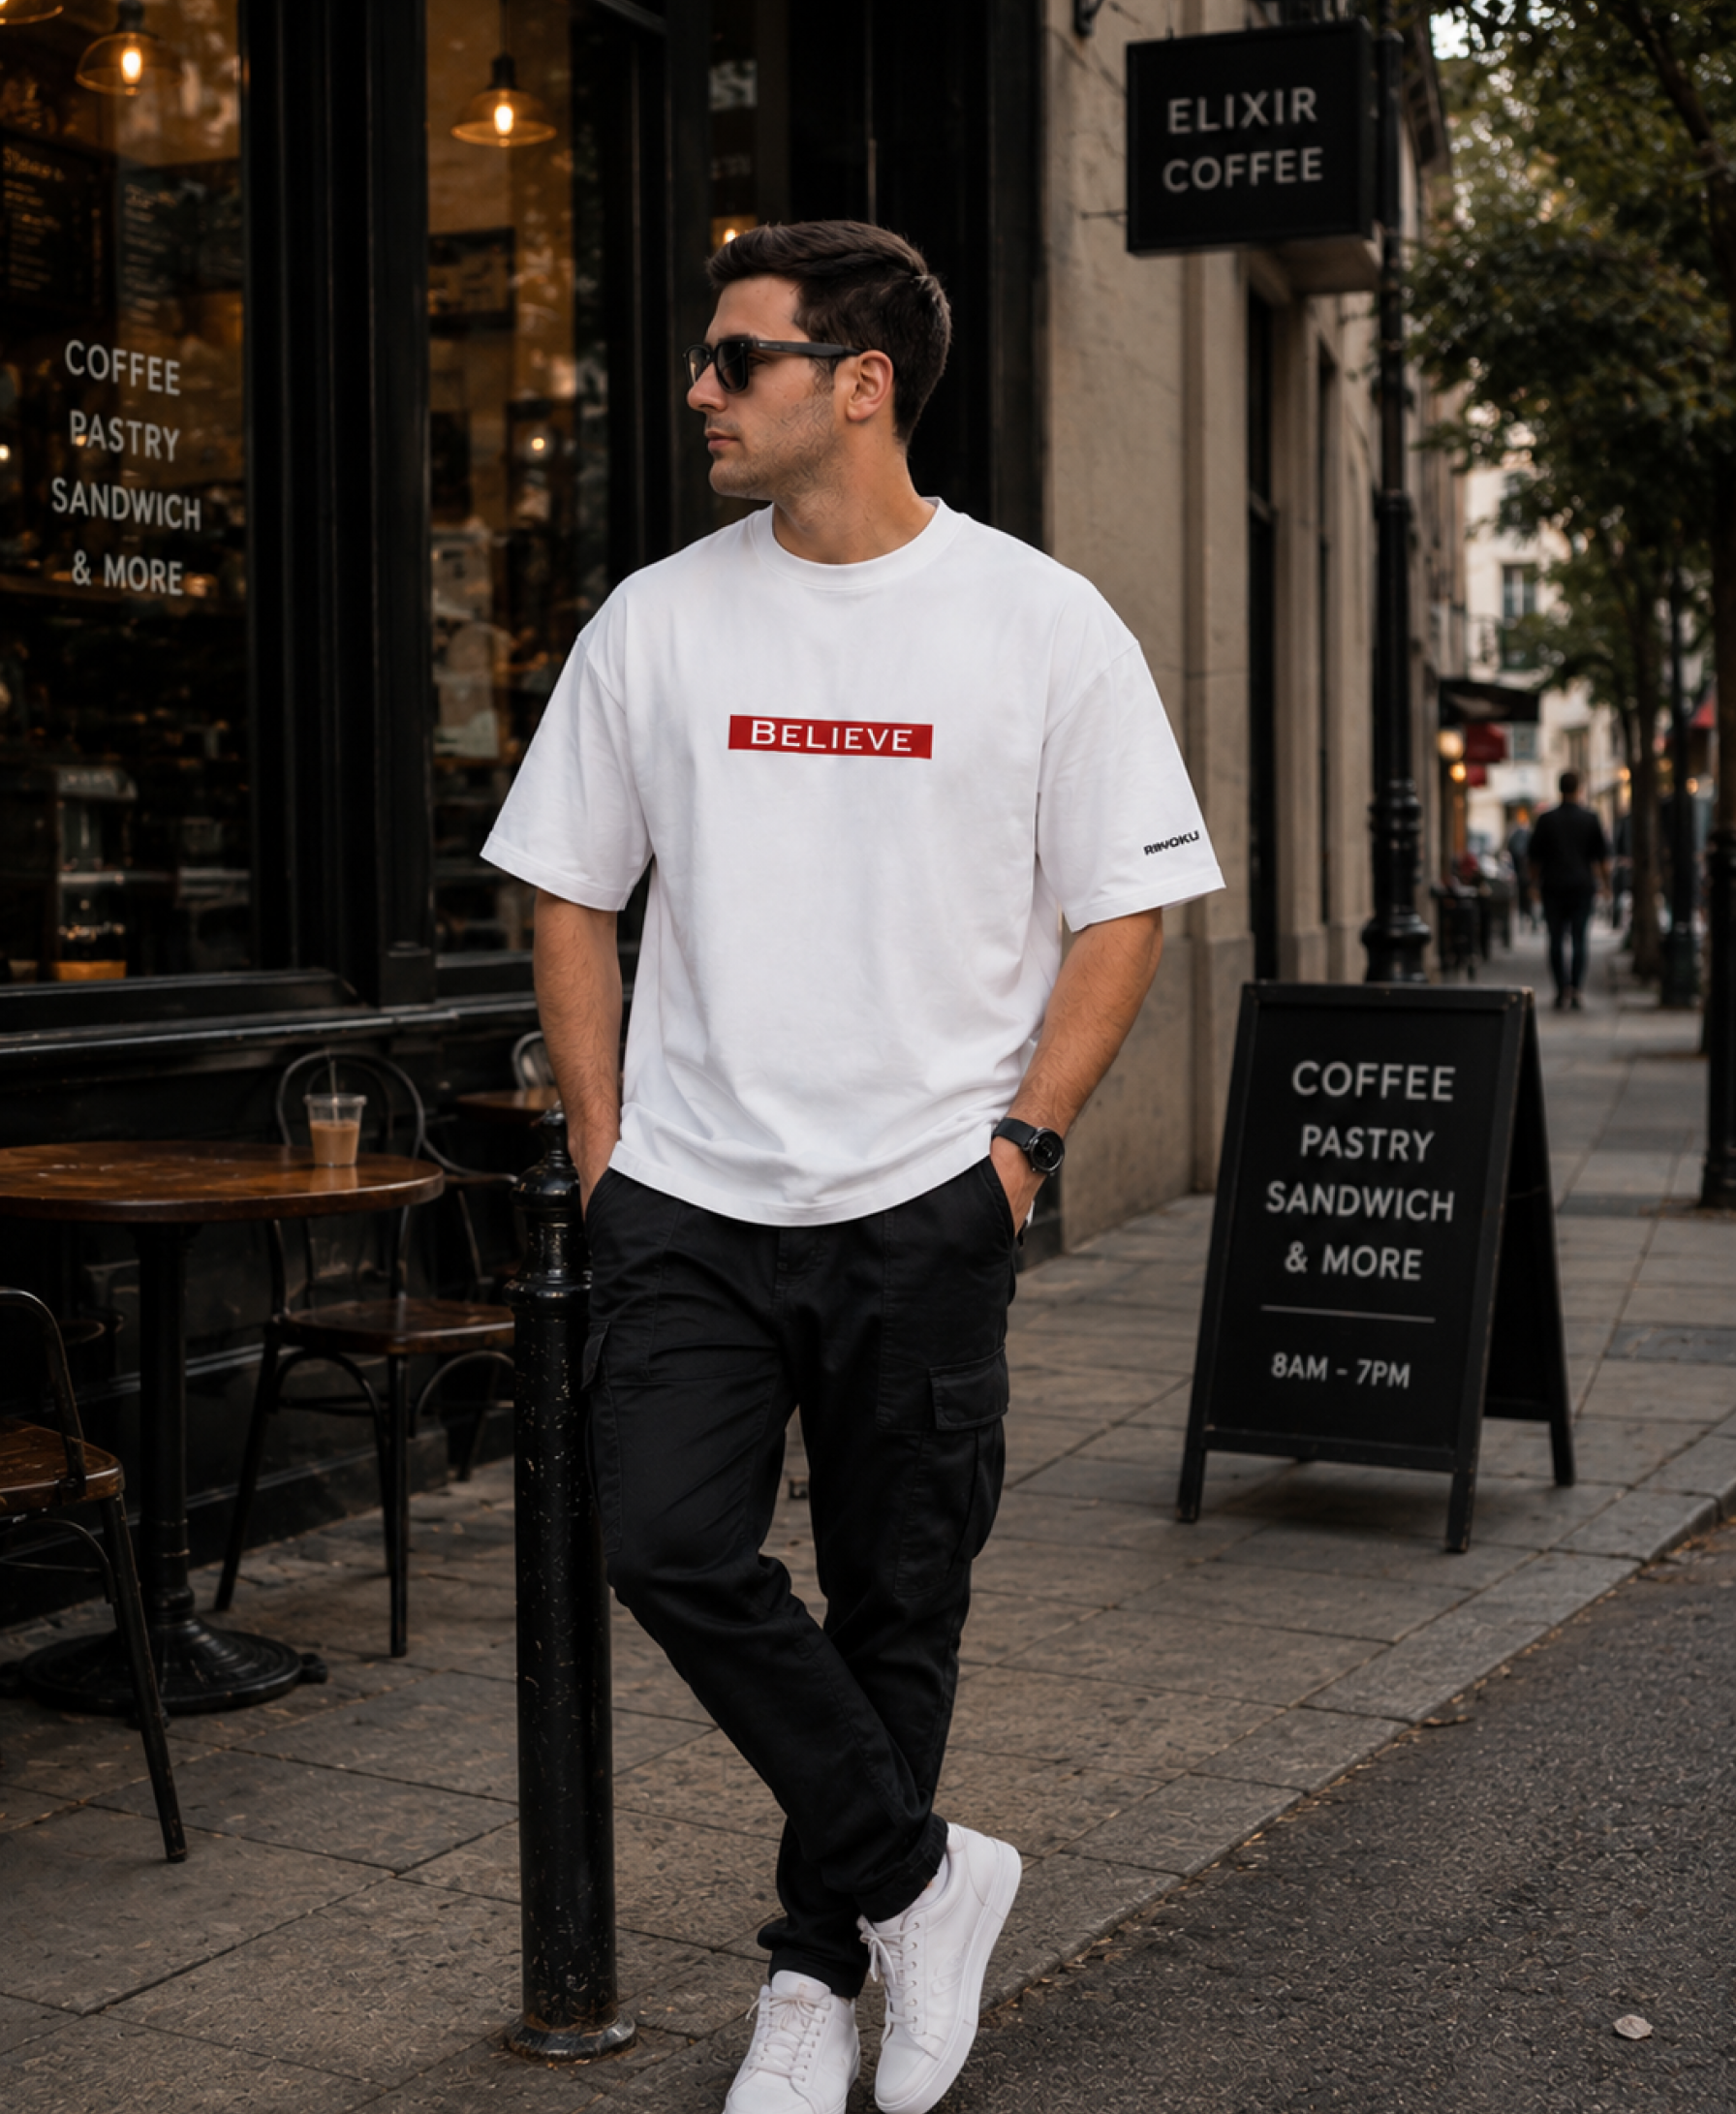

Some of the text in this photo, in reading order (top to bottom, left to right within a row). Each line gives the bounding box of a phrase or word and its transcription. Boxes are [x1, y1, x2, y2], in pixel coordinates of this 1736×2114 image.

[1168, 86, 1318, 134] ELIXIR
[1163, 147, 1323, 193] COFFEE
[65, 339, 181, 396] COFFEE
[70, 409, 179, 463] PASTRY
[51, 477, 202, 532] SANDWICH
[72, 549, 183, 596] & MORE
[751, 720, 913, 752] BELIEVE
[1292, 1060, 1456, 1102] COFFEE
[1300, 1124, 1435, 1163] PASTRY
[1265, 1180, 1455, 1223] SANDWICH
[1285, 1241, 1423, 1281] & MORE
[1271, 1352, 1328, 1382] 8AM
[1356, 1358, 1410, 1389] 7PM
